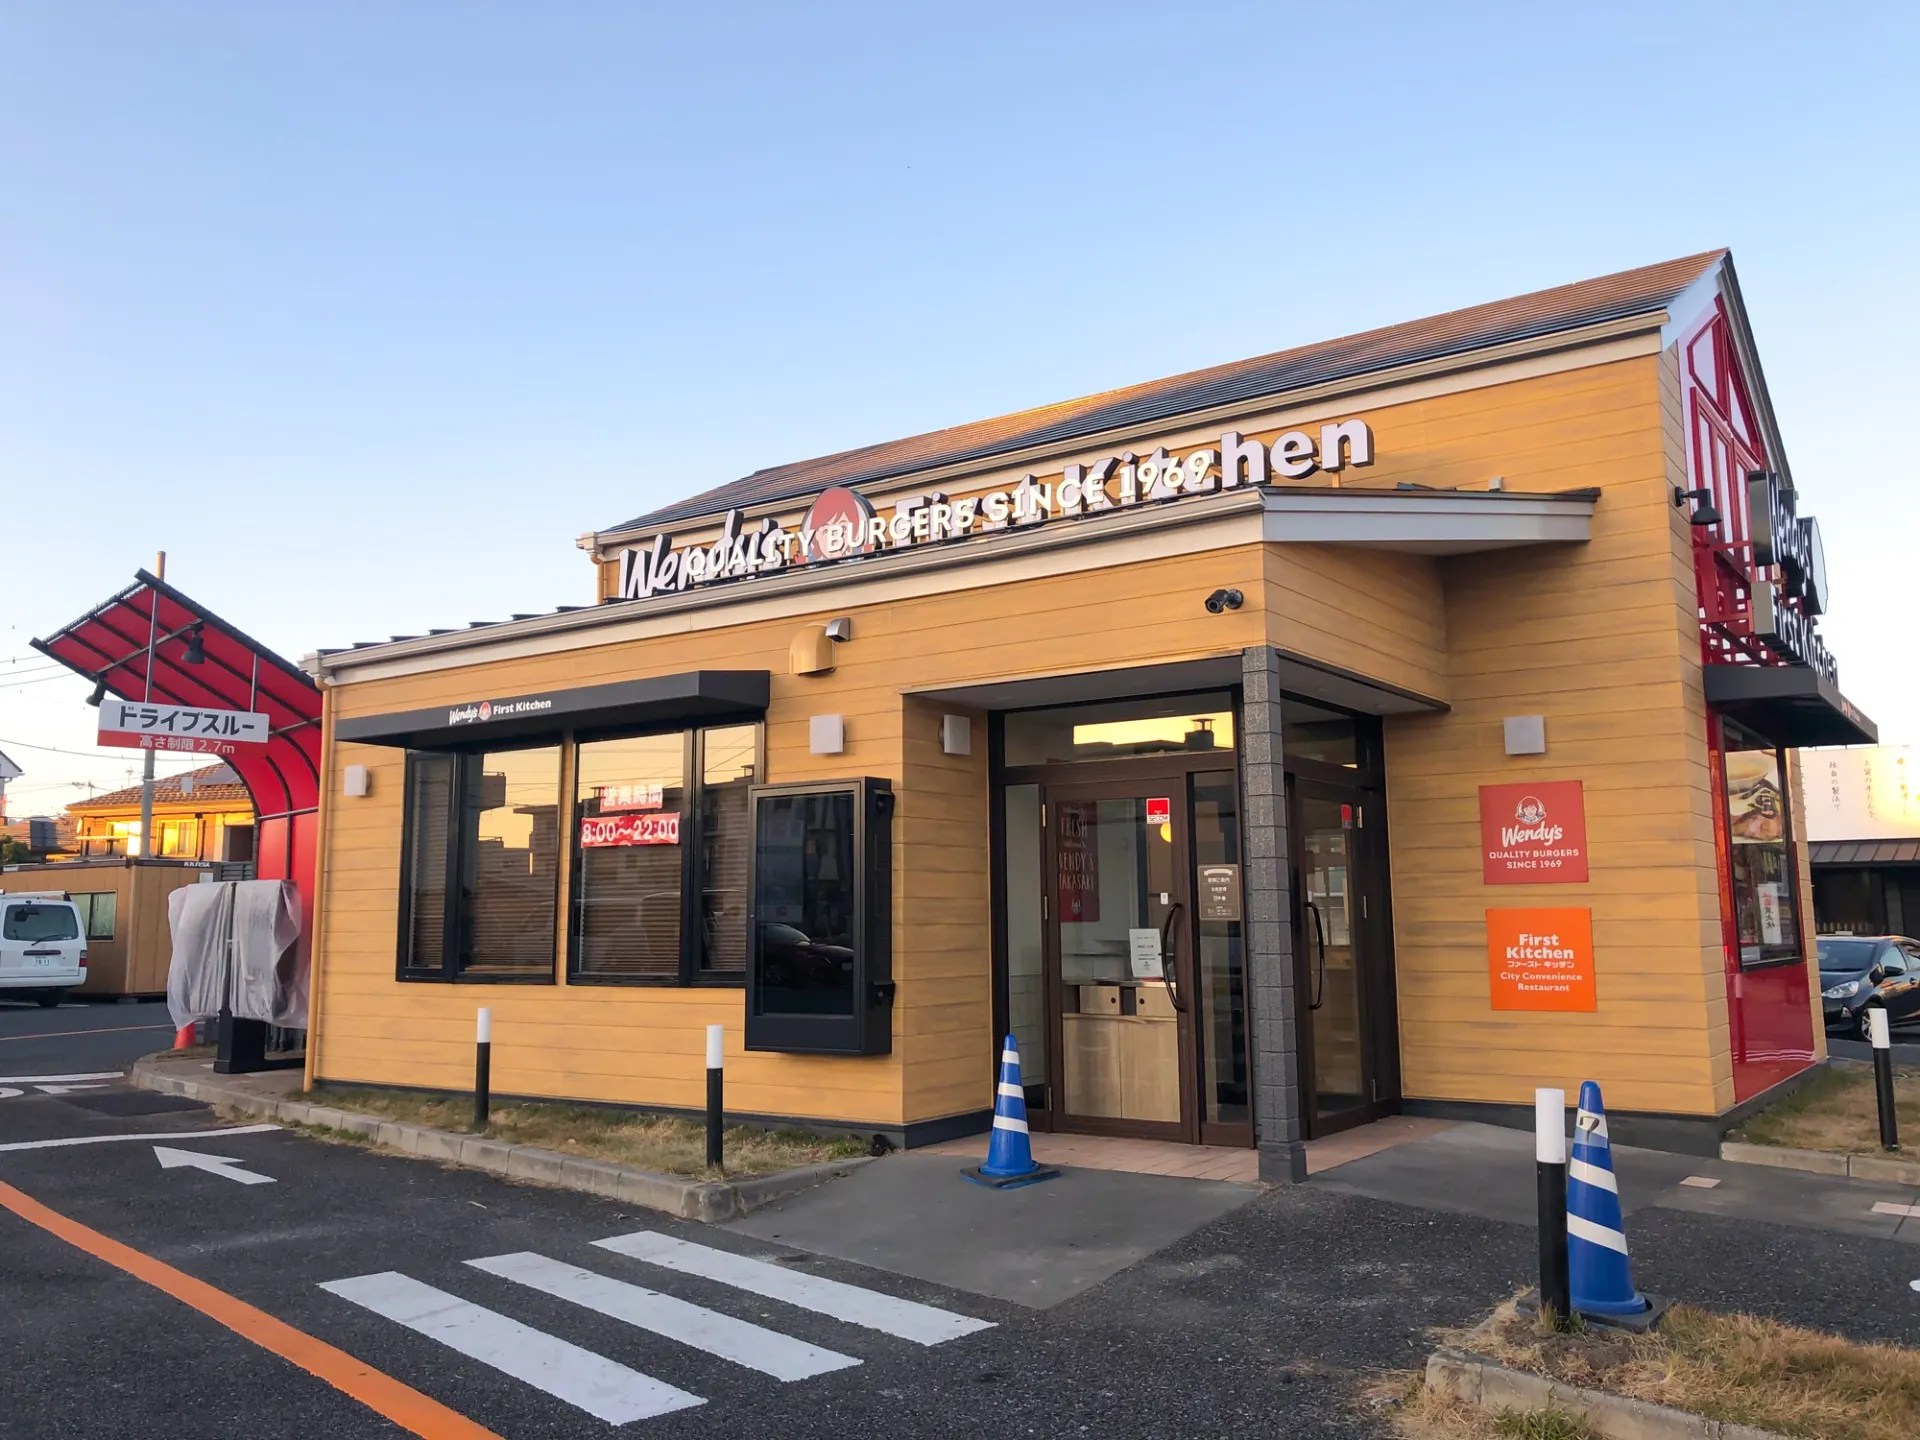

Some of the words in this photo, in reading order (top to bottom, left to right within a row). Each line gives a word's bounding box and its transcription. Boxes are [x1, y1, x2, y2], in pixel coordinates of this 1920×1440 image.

[618, 508, 785, 600] Wendy's
[1064, 418, 1371, 517] Kitchen
[686, 530, 816, 577] QUALITY
[828, 499, 975, 554] BURGERS
[988, 474, 1105, 522] SINCE
[1119, 451, 1211, 498] 1969
[119, 705, 255, 736] ドライブスルー
[449, 704, 478, 725] Wendy's
[493, 703, 514, 716] First
[516, 700, 551, 713] Kitchen
[139, 735, 194, 751] 高さ制限
[199, 740, 235, 754] 2.7m
[1501, 821, 1563, 848] Wendy's
[1489, 850, 1530, 859] QUALITY
[1533, 849, 1579, 858] BURGERS
[1506, 860, 1537, 869] SINCE
[1540, 860, 1562, 868] 1969
[1519, 933, 1560, 946] First
[1506, 946, 1574, 959] Kitchen
[1500, 972, 1520, 981] City
[1522, 972, 1582, 981] Convenience
[1517, 982, 1570, 991] Restaurant
